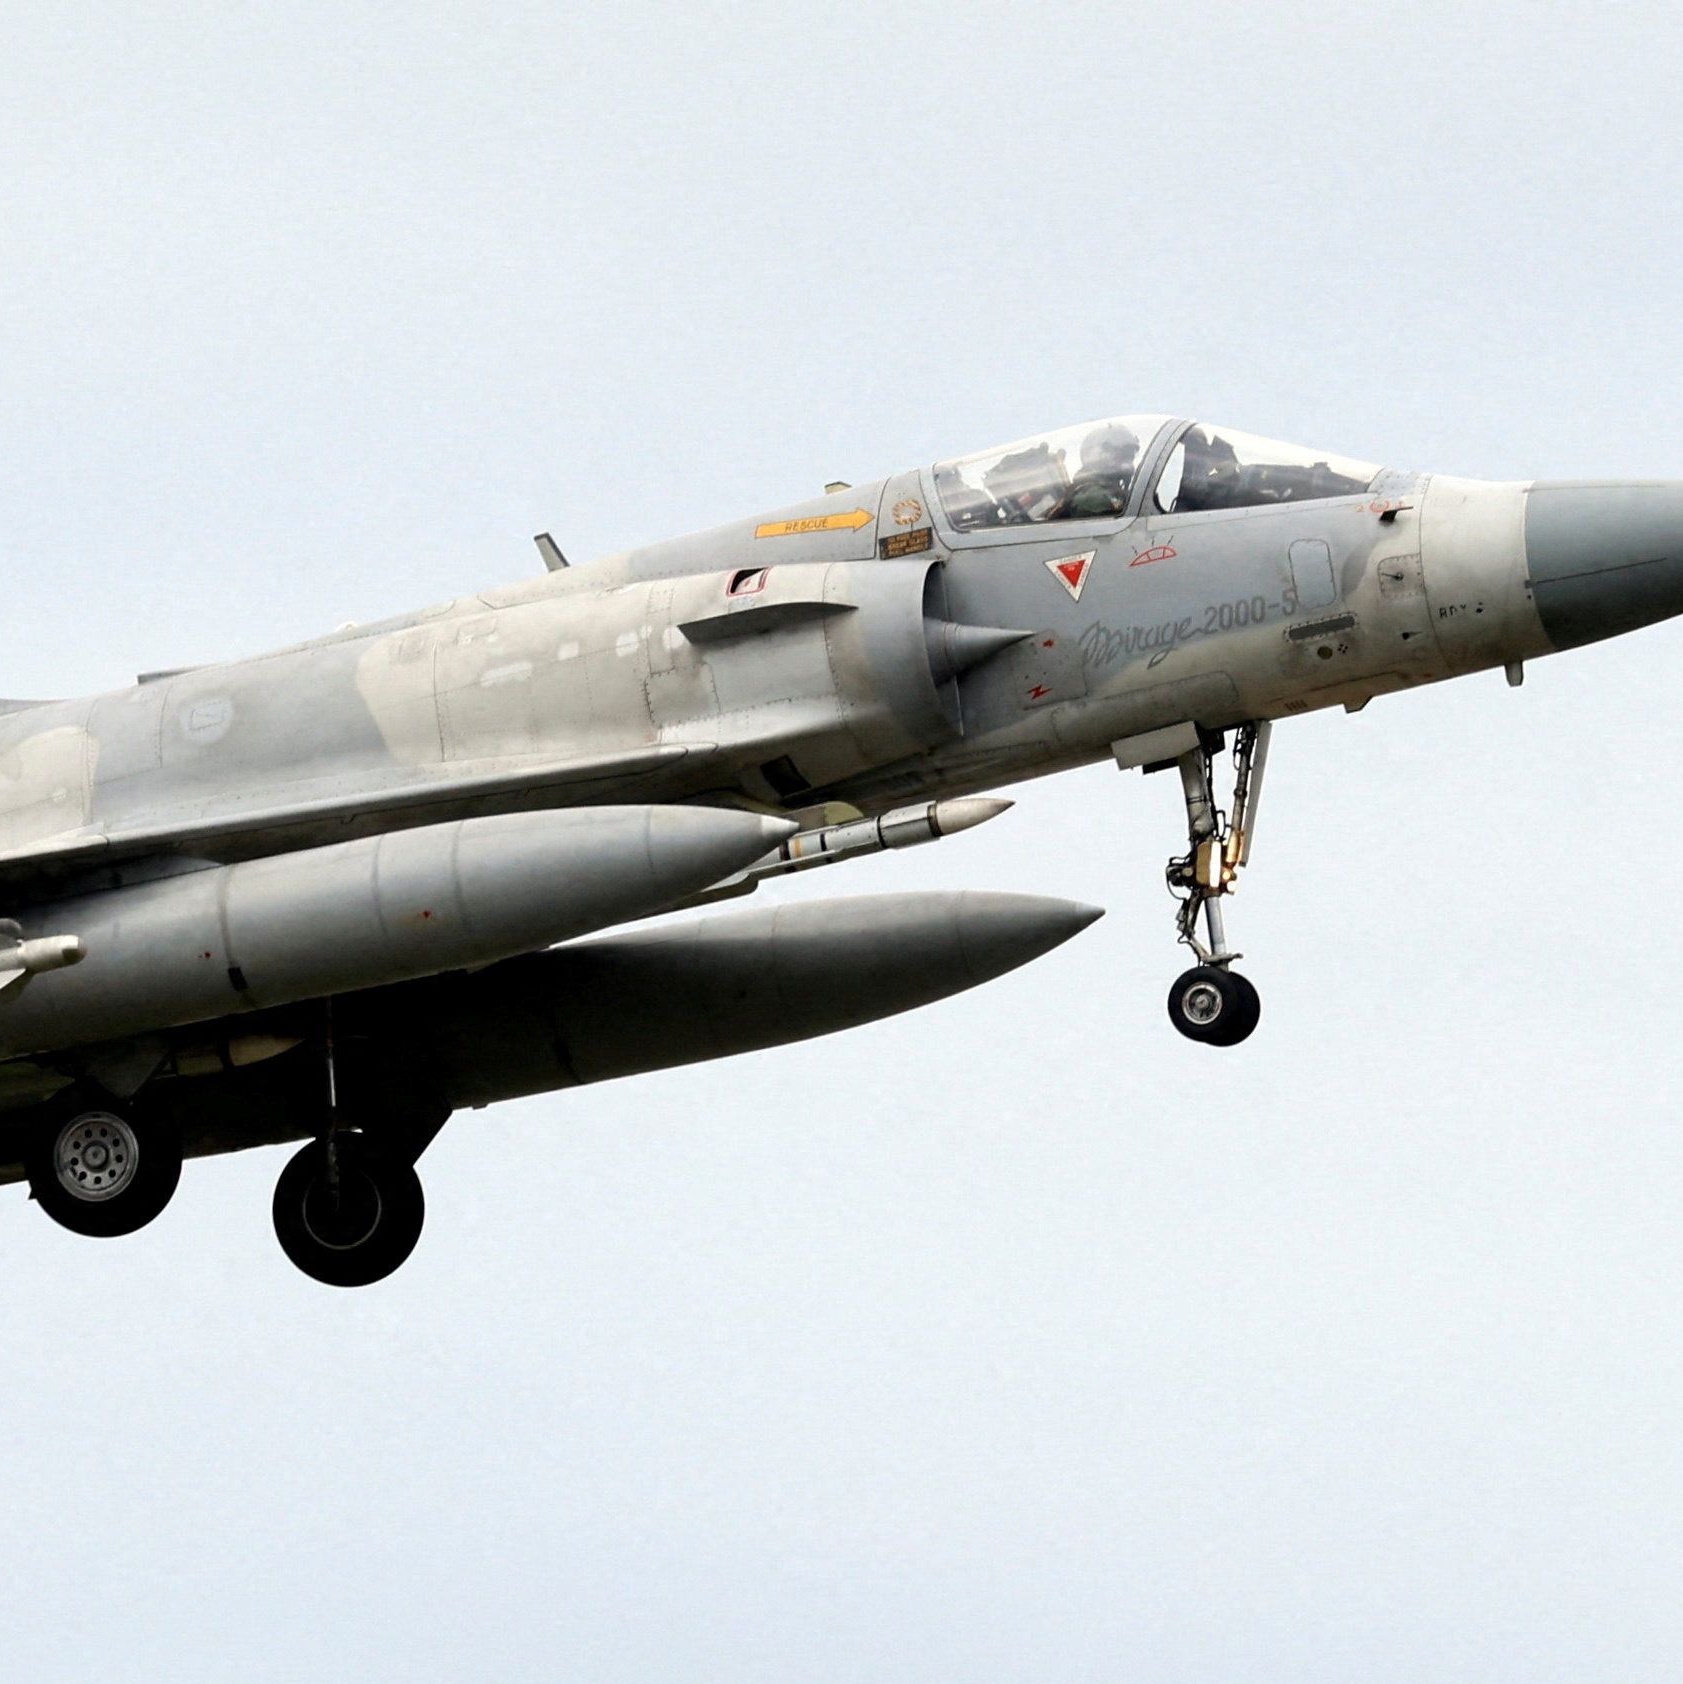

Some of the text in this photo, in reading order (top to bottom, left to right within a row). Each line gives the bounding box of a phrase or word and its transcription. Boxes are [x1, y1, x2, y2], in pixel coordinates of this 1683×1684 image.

[785, 518, 828, 532] RESCUE
[1078, 588, 1297, 670] Mirage 2000-5
